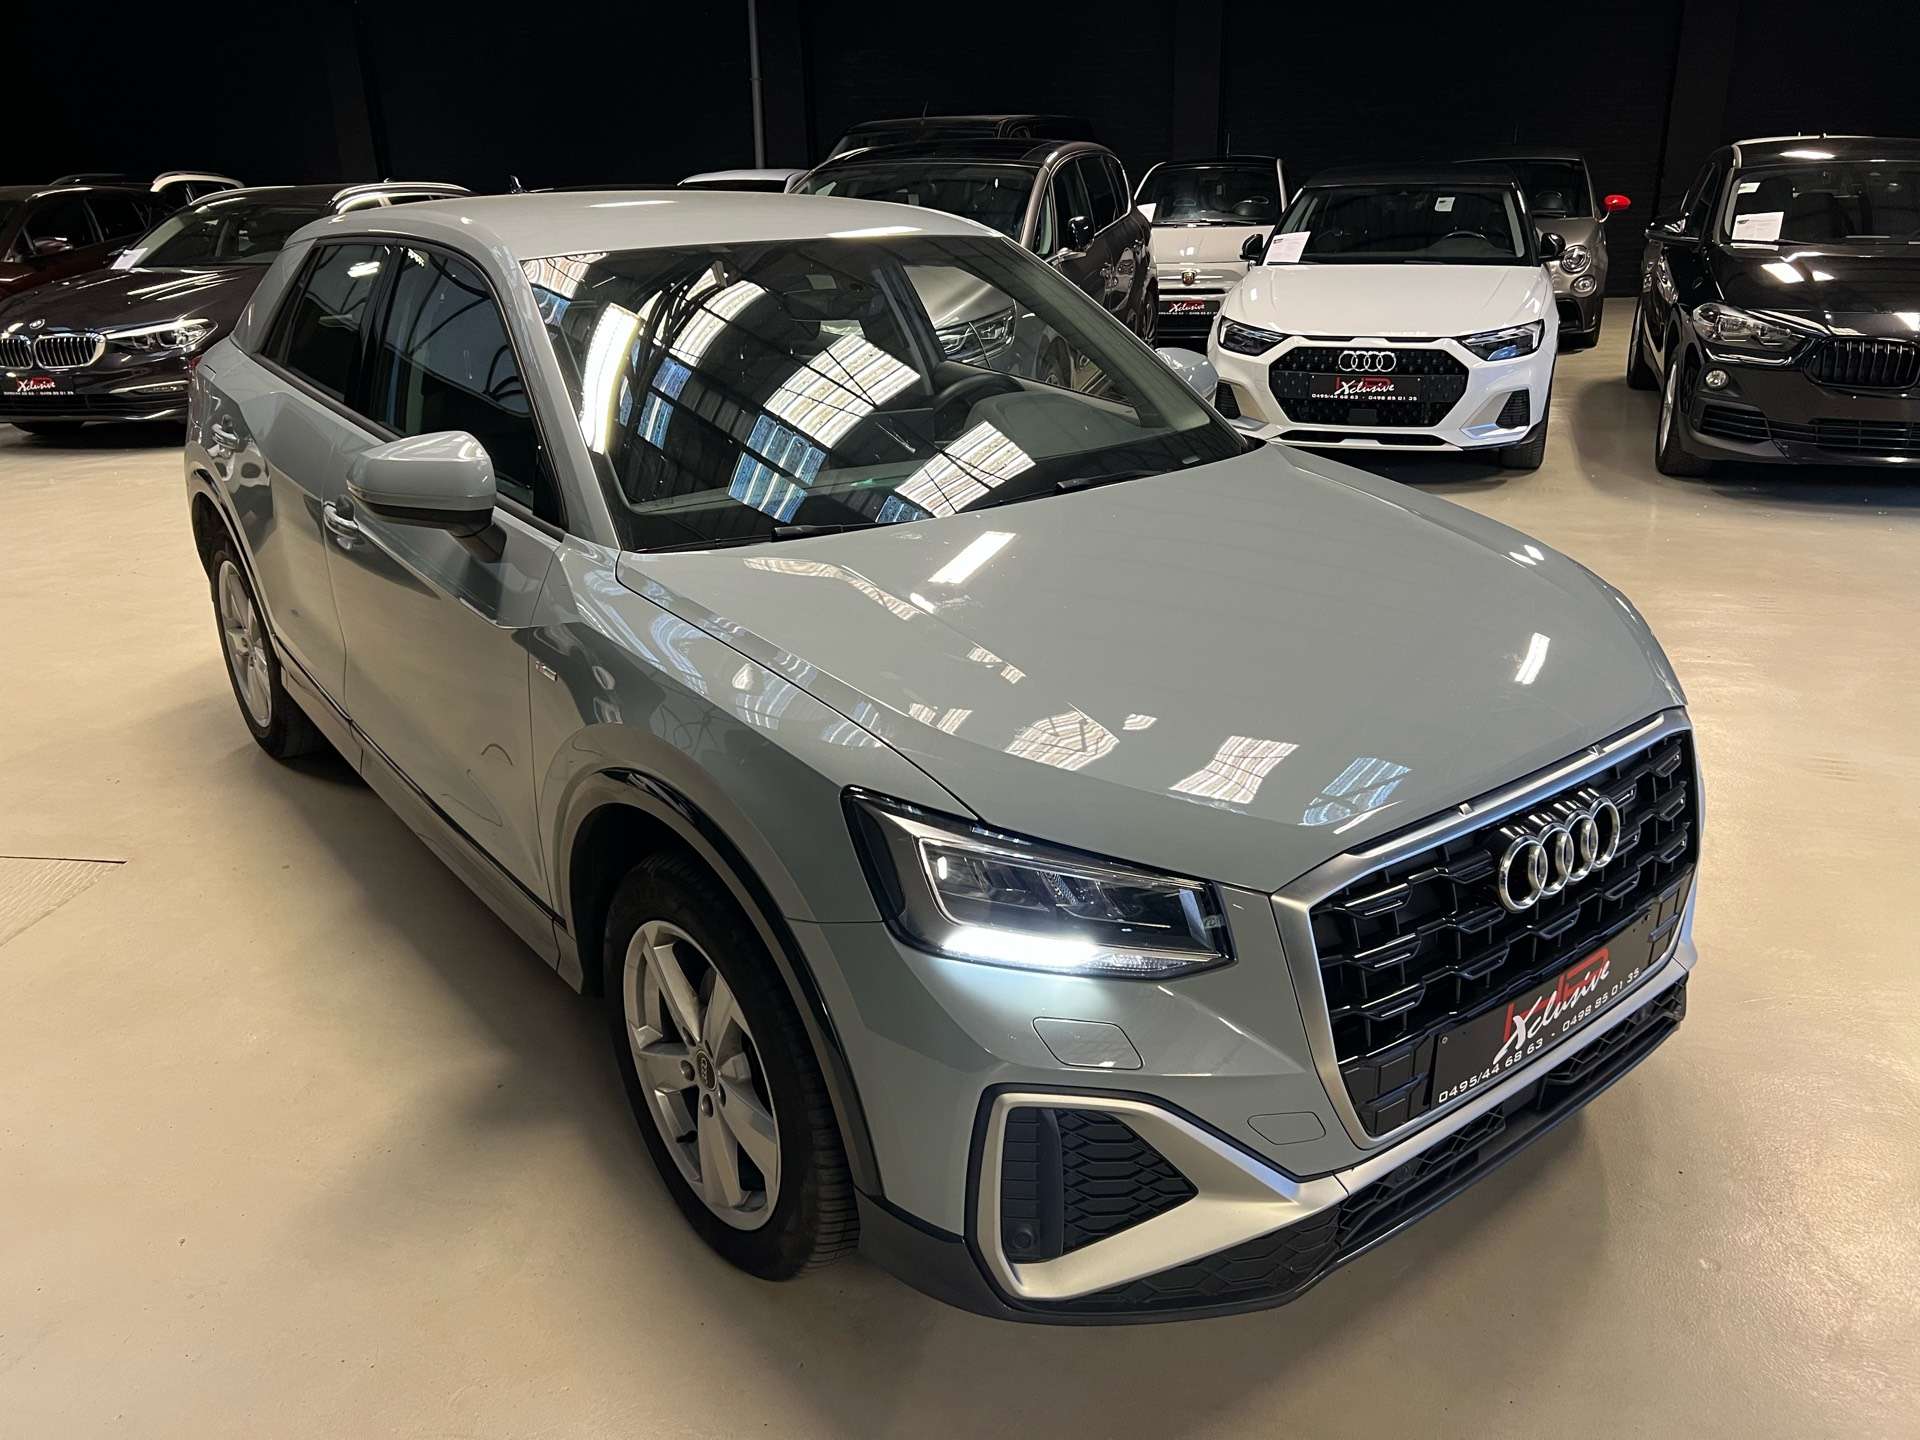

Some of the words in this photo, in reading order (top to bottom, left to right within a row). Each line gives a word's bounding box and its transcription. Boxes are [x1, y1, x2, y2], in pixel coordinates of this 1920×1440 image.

[17, 379, 56, 392] Xclusive
[1334, 379, 1395, 395] Xclusive
[1438, 1063, 1500, 1104] 0495/44
[1505, 1051, 1522, 1067] 68
[1527, 1038, 1543, 1054] 63
[1562, 1004, 1592, 1032] 0498
[1611, 980, 1623, 996] 01
[1493, 960, 1610, 1064] Xclusive
